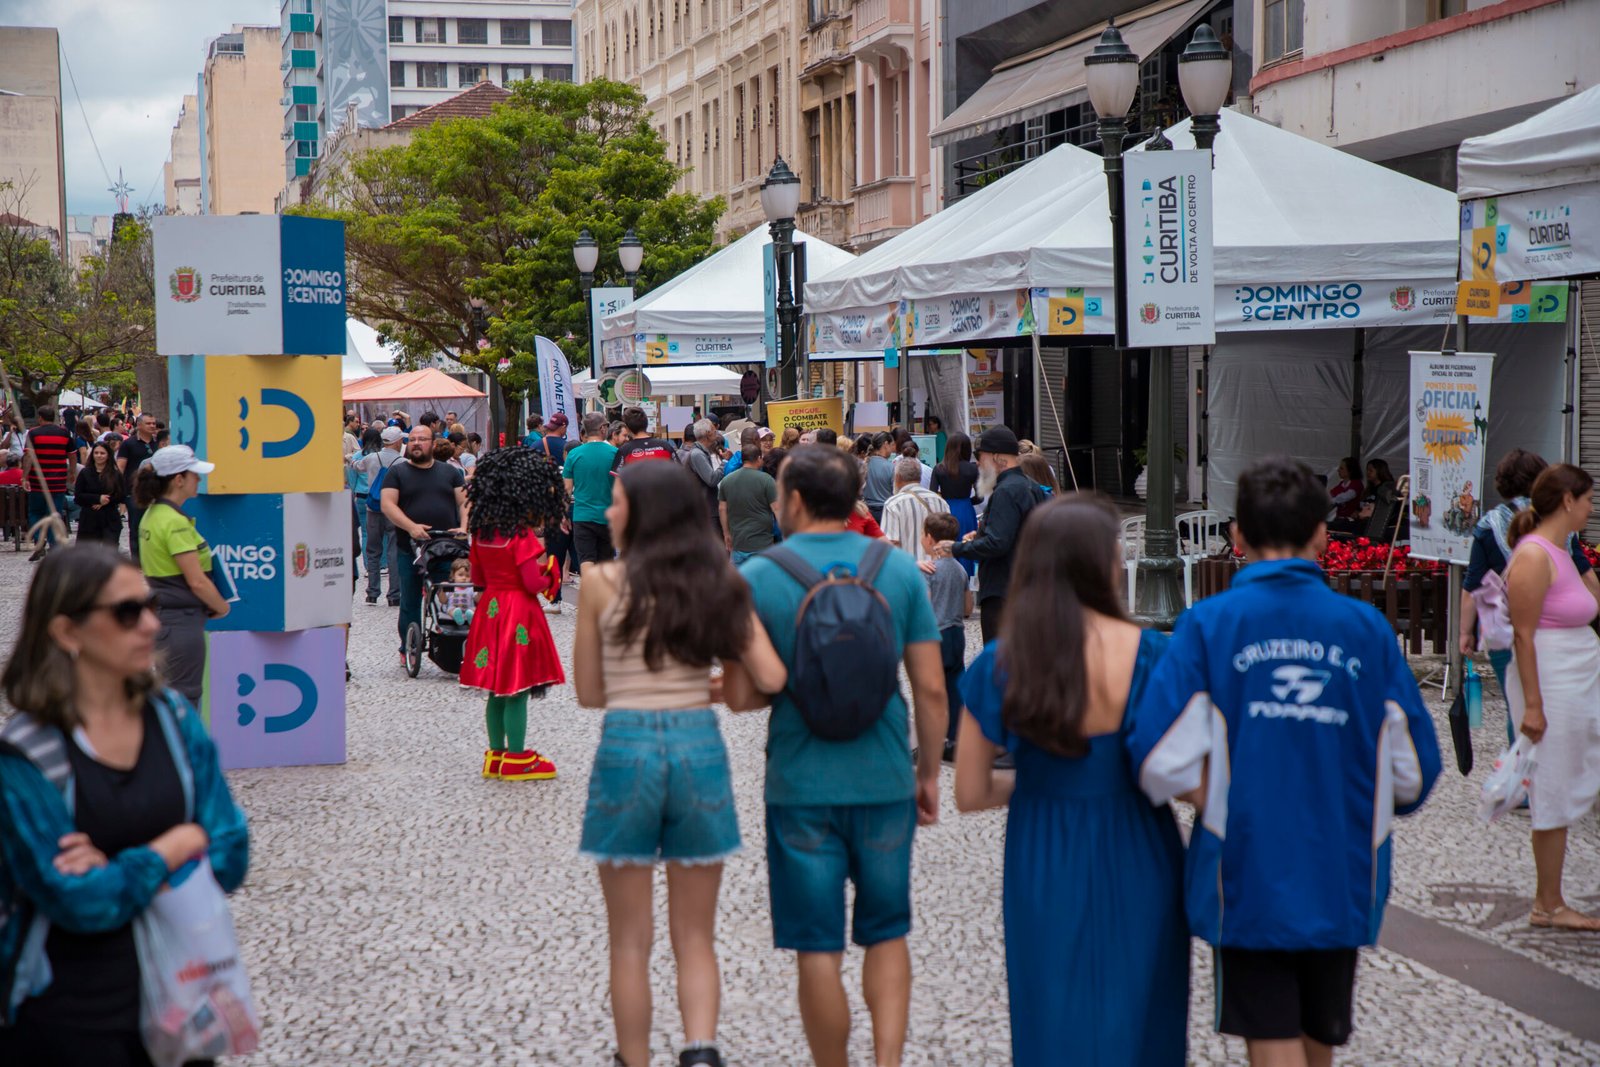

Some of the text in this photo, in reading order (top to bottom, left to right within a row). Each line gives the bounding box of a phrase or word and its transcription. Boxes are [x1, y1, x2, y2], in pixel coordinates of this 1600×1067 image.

[1158, 175, 1179, 284] CURITIBA
[1188, 174, 1198, 283] DE VOLTA AO CENTRO
[1528, 222, 1571, 245] CURITIBA
[211, 274, 264, 283] Prefeitura de
[284, 268, 341, 287] DOMINGO
[209, 285, 266, 296] CURITIBA
[293, 286, 342, 304] CENTRO
[1235, 283, 1362, 304] DOMINGO
[1423, 289, 1456, 297] Prefeitura
[1422, 296, 1458, 306] CURITIB
[1165, 312, 1201, 320] CURITIBA
[1242, 305, 1252, 323] NO
[1254, 302, 1361, 321] CENTRO
[695, 343, 733, 352] CURITIBA
[1423, 390, 1476, 410] OFICIAL
[784, 421, 815, 429] COMEÇA
[792, 413, 828, 422] COMBATE
[1421, 428, 1476, 446] CURITIBA
[314, 557, 344, 569] CURITIBA
[1232, 638, 1325, 673] CRUZEIRO
